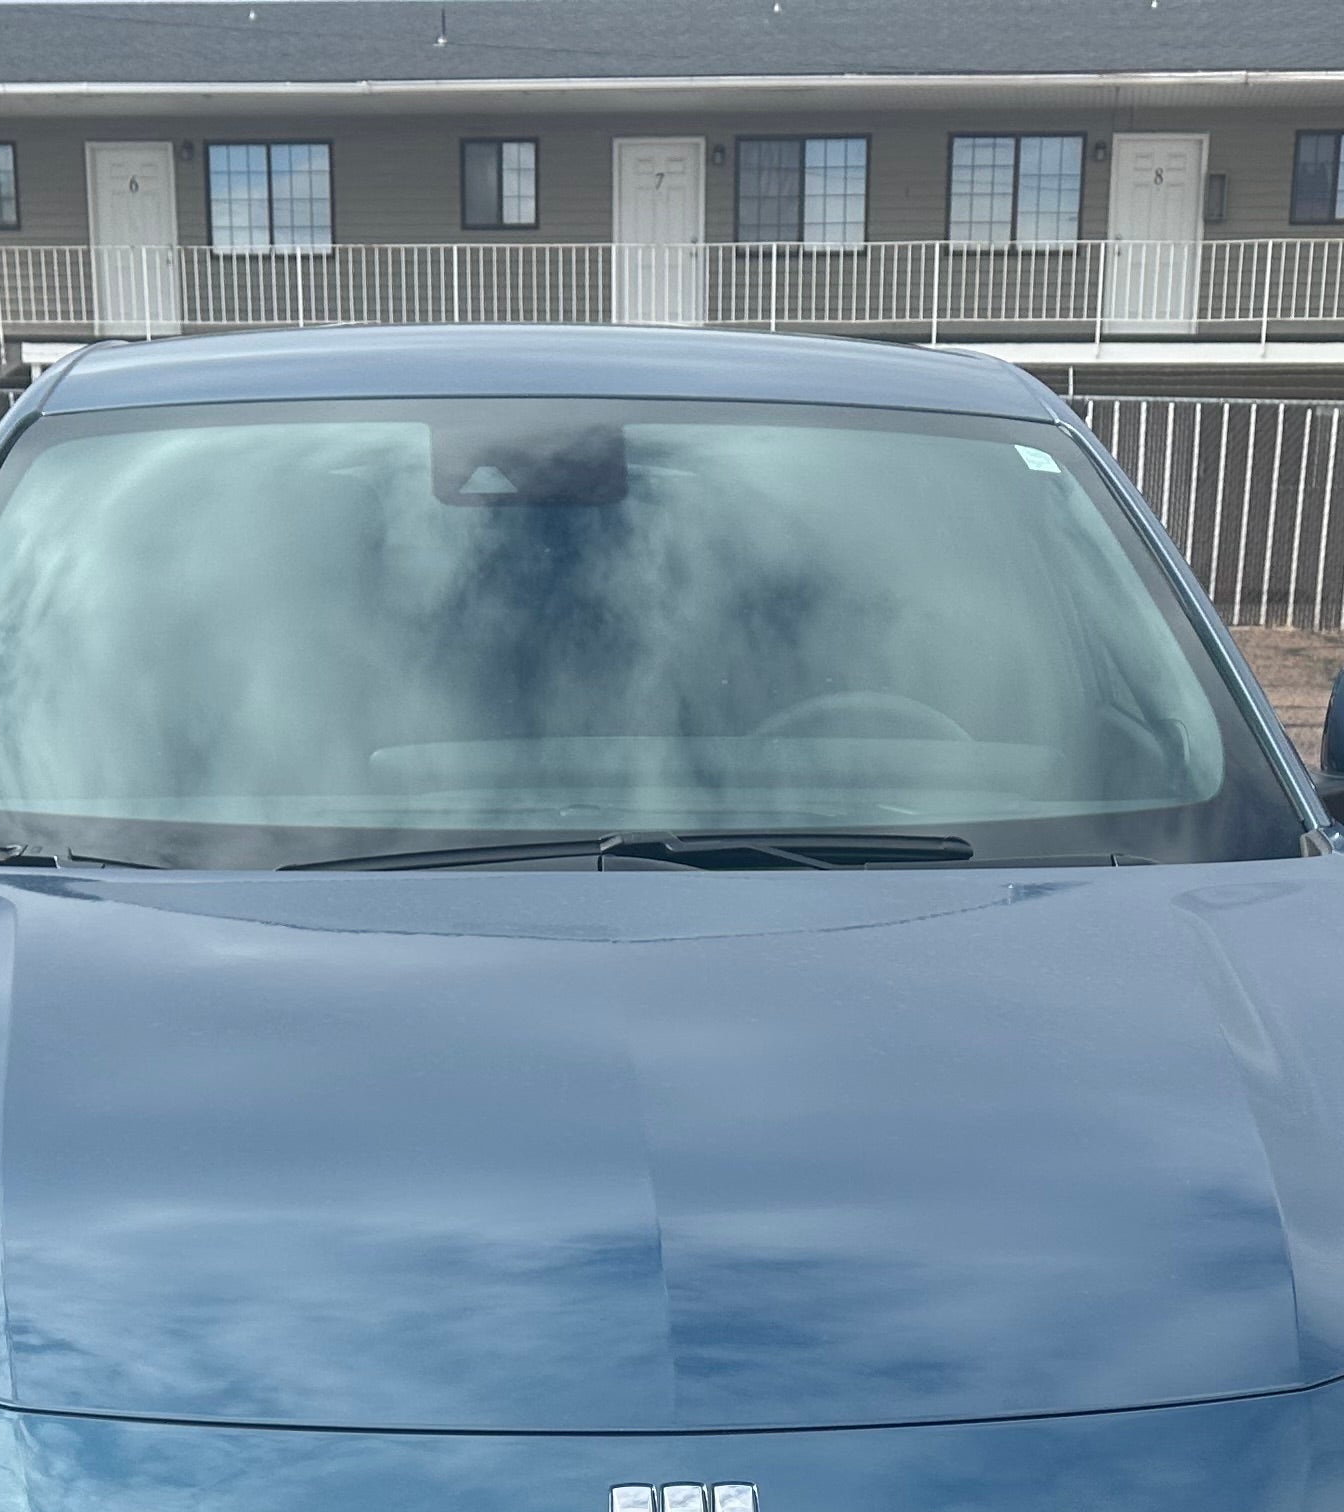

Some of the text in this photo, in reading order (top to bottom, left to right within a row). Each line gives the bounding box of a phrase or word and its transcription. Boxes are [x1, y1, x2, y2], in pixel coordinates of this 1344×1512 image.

[129, 175, 140, 193] 6
[655, 172, 665, 190] 7
[1154, 167, 1164, 186] 8
